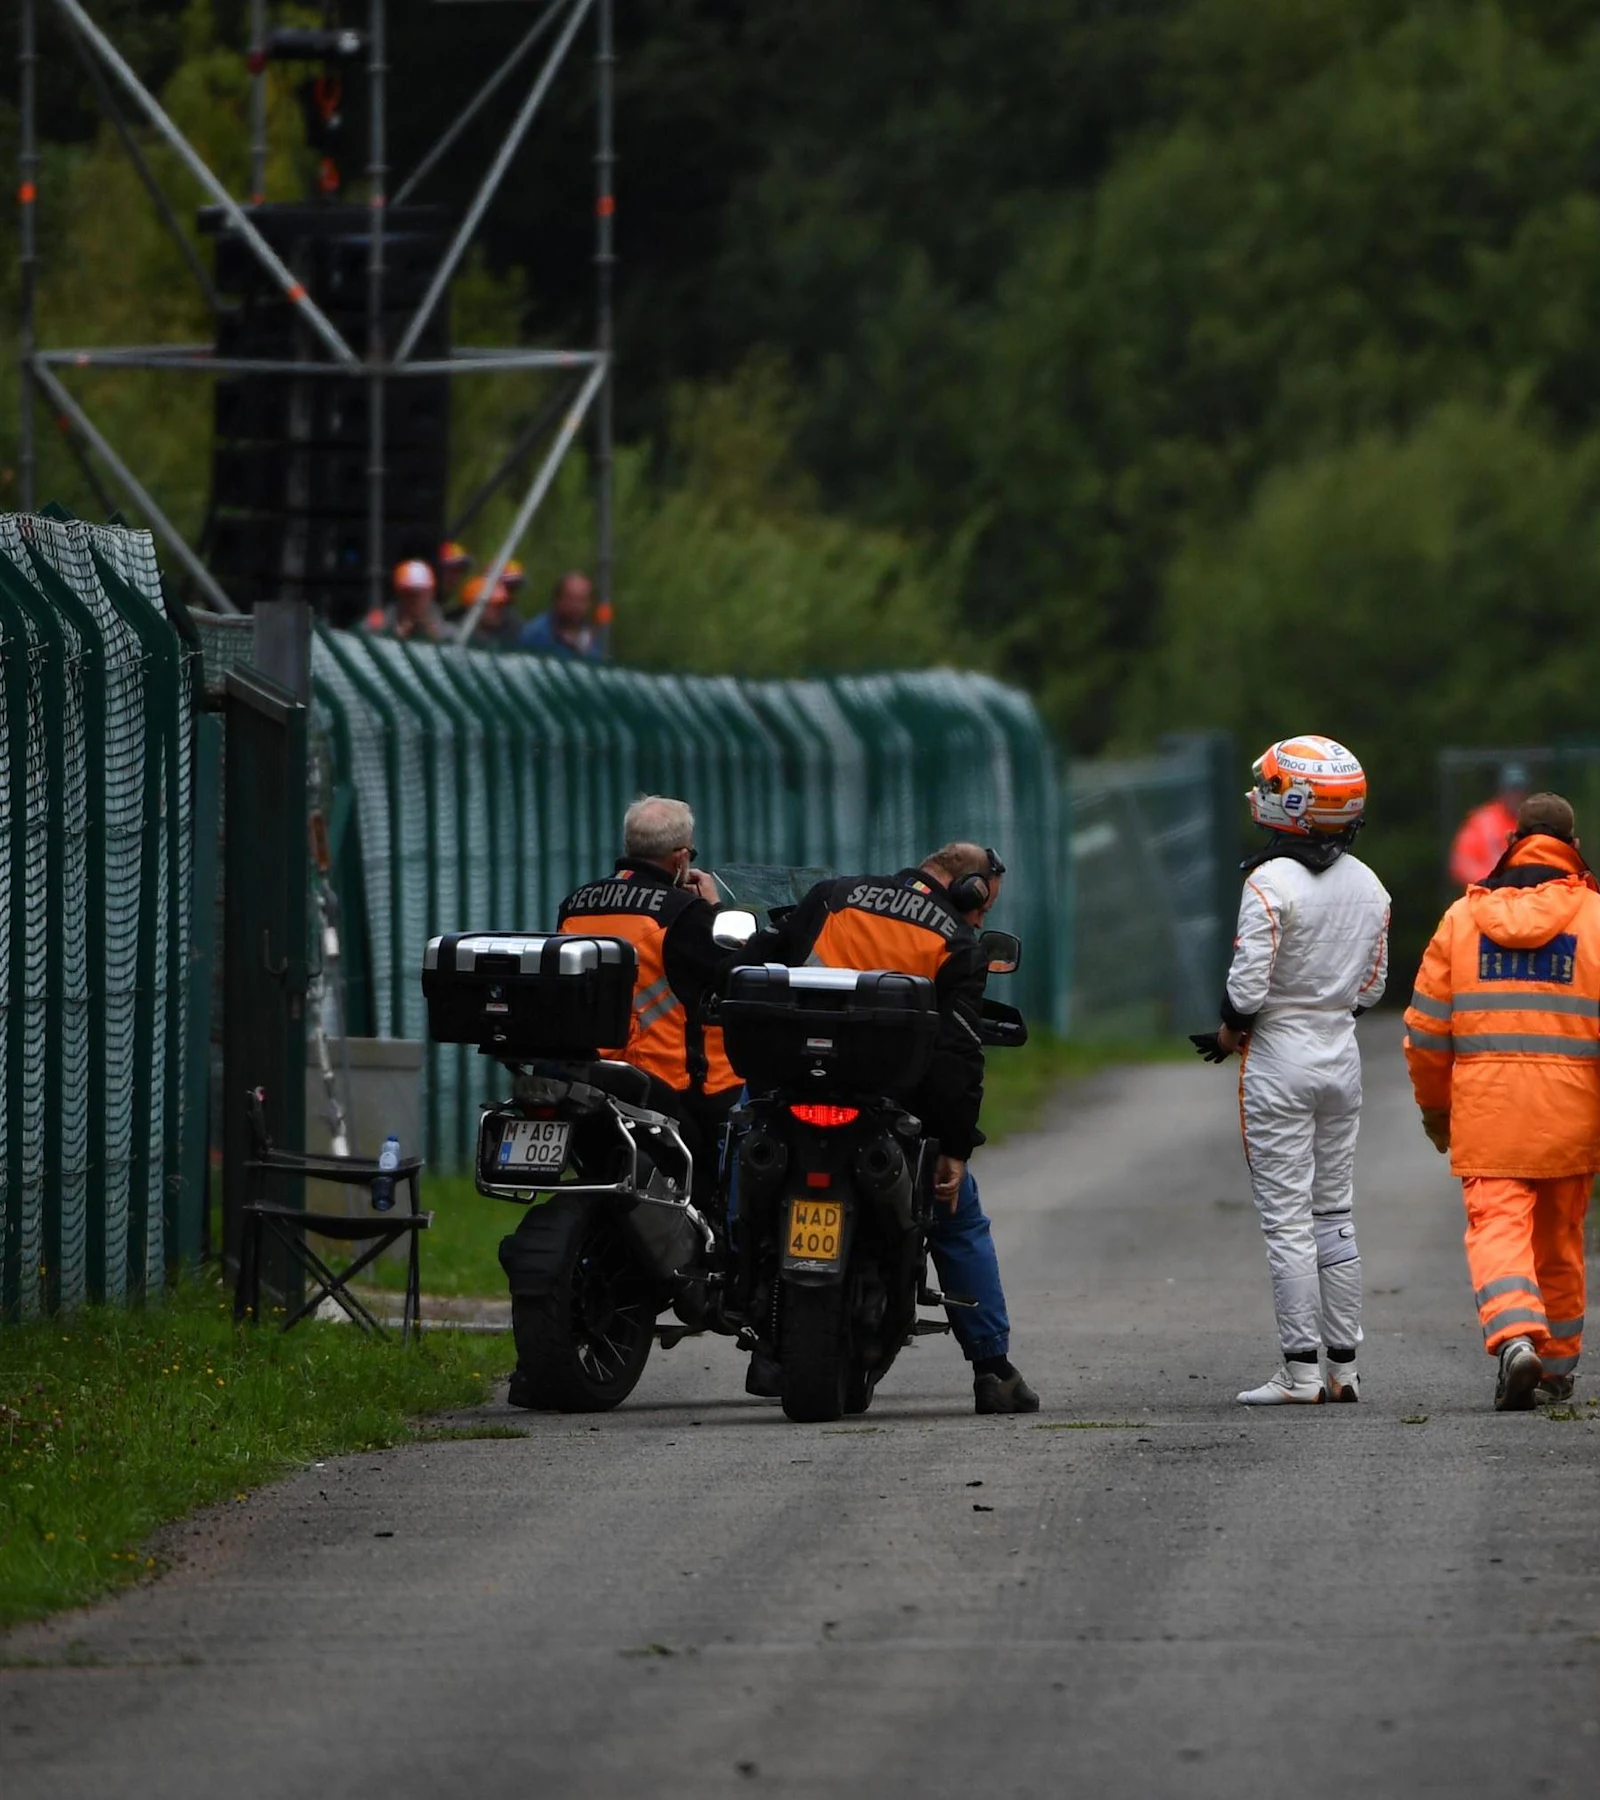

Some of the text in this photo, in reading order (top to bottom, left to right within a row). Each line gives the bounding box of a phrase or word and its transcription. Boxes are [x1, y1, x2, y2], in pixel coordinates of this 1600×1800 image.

[1284, 794, 1303, 810] 2
[567, 883, 668, 912] SECURITE
[846, 884, 958, 938] SECURITE
[525, 1144, 563, 1163] 002
[796, 1205, 837, 1227] WAD
[791, 1232, 835, 1253] 400
